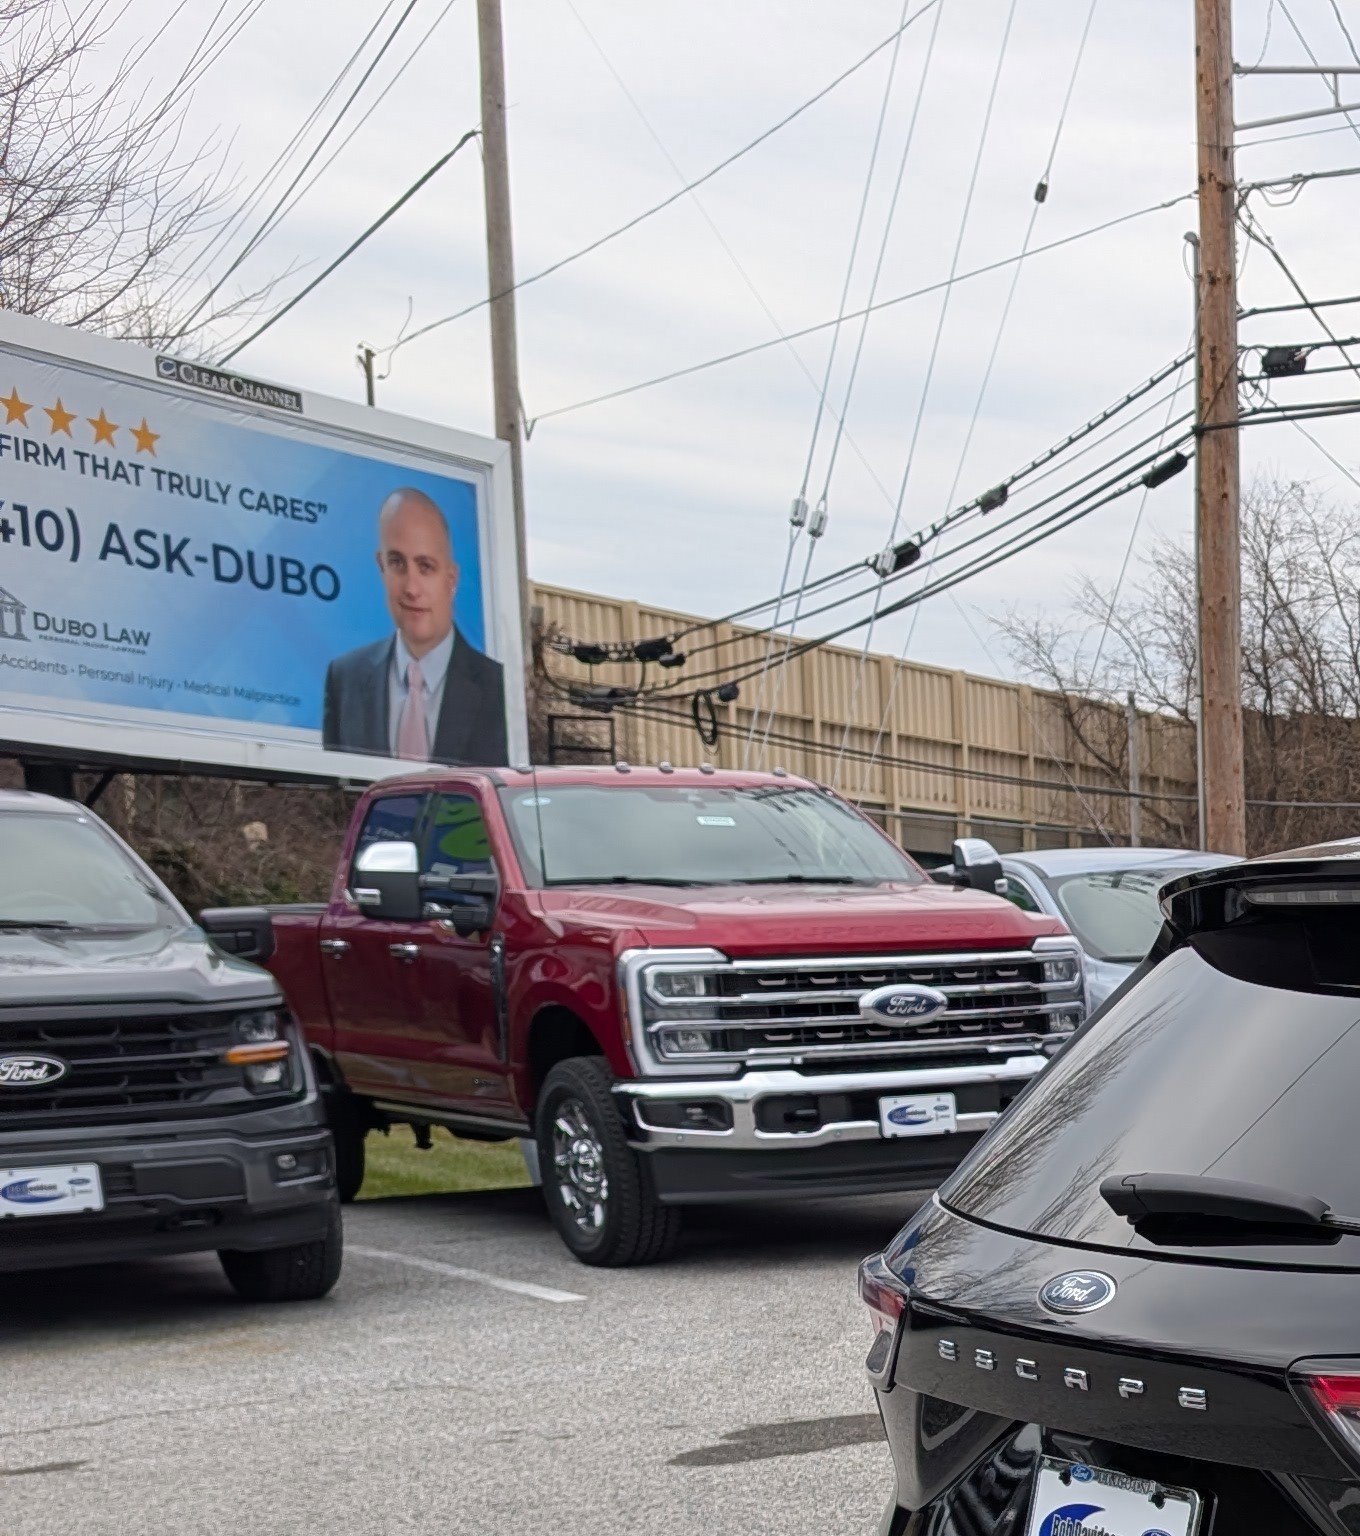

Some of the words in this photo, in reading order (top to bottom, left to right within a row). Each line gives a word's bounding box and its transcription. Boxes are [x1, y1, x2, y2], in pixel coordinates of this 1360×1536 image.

[0, 433, 66, 471] FIRM
[73, 450, 145, 487] THAT
[151, 467, 232, 505] TRULY
[98, 521, 341, 602] ASK-DUBO
[0, 653, 68, 676] Accidents
[78, 663, 135, 685] Personal
[138, 673, 174, 693] Injury
[183, 678, 231, 698] Medical
[233, 686, 301, 707] Malpractice
[886, 995, 926, 1014] Ford
[0, 1060, 49, 1081] Ford
[1050, 1275, 1097, 1303] Ford
[937, 1339, 1208, 1411] ESCAPE
